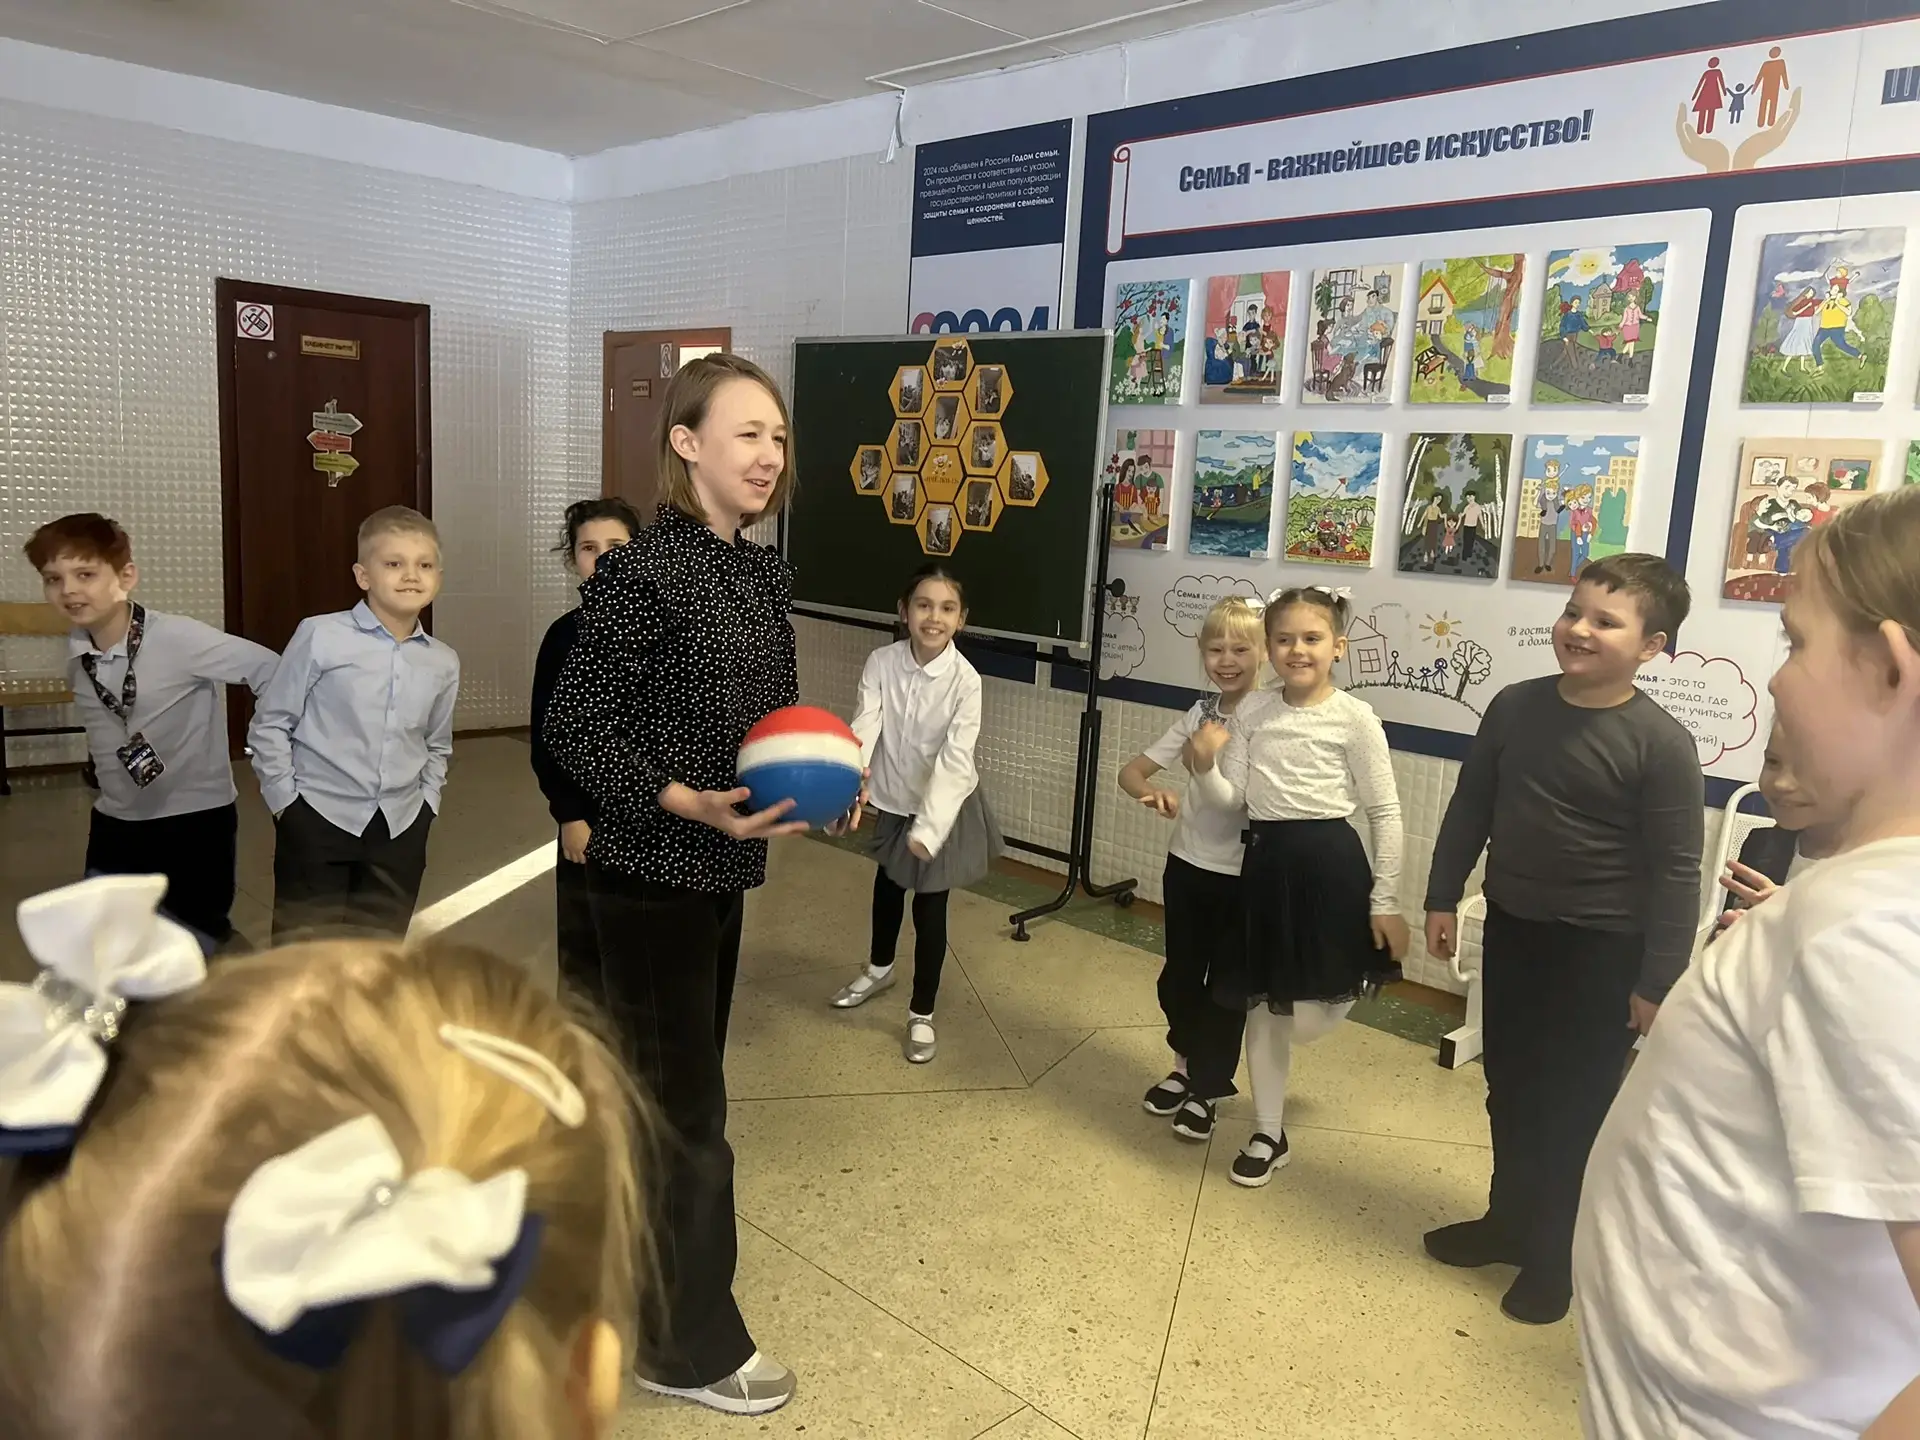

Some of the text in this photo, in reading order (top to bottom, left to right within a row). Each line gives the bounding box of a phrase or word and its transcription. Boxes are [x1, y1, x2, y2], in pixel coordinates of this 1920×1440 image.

[1180, 162, 1251, 192] Семья
[1267, 139, 1420, 181] важнейшее
[1425, 109, 1594, 161] искусство!
[923, 166, 938, 176] 2024
[938, 166, 948, 174] год
[950, 162, 979, 172] объявлен
[985, 157, 1010, 167] России
[1011, 153, 1034, 162] Годом
[1035, 149, 1060, 159] семьи.
[925, 178, 935, 187] Он
[936, 173, 972, 185] проводится
[978, 167, 1021, 179] соответствии
[1029, 161, 1056, 172] указом
[920, 187, 956, 199] президента
[957, 184, 981, 192] России
[987, 180, 1006, 189] целях
[1007, 173, 1061, 185] популяризации
[930, 192, 985, 207] государственной
[986, 190, 1016, 200] политики
[1023, 185, 1049, 196] сфере
[923, 210, 947, 219] защиты
[949, 207, 969, 216] семьи
[975, 201, 1016, 213] сохранения
[1017, 196, 1055, 208] семейных
[966, 212, 1006, 225] ценностей.
[1176, 589, 1200, 599] Семья
[1176, 601, 1207, 610] основой
[1508, 626, 1553, 637] В гостя
[1518, 639, 1525, 647] а
[1669, 677, 1690, 687] это
[1693, 680, 1706, 689] та
[1662, 690, 1704, 704] среда,
[1708, 696, 1729, 706] где
[1689, 706, 1733, 720] учиться
